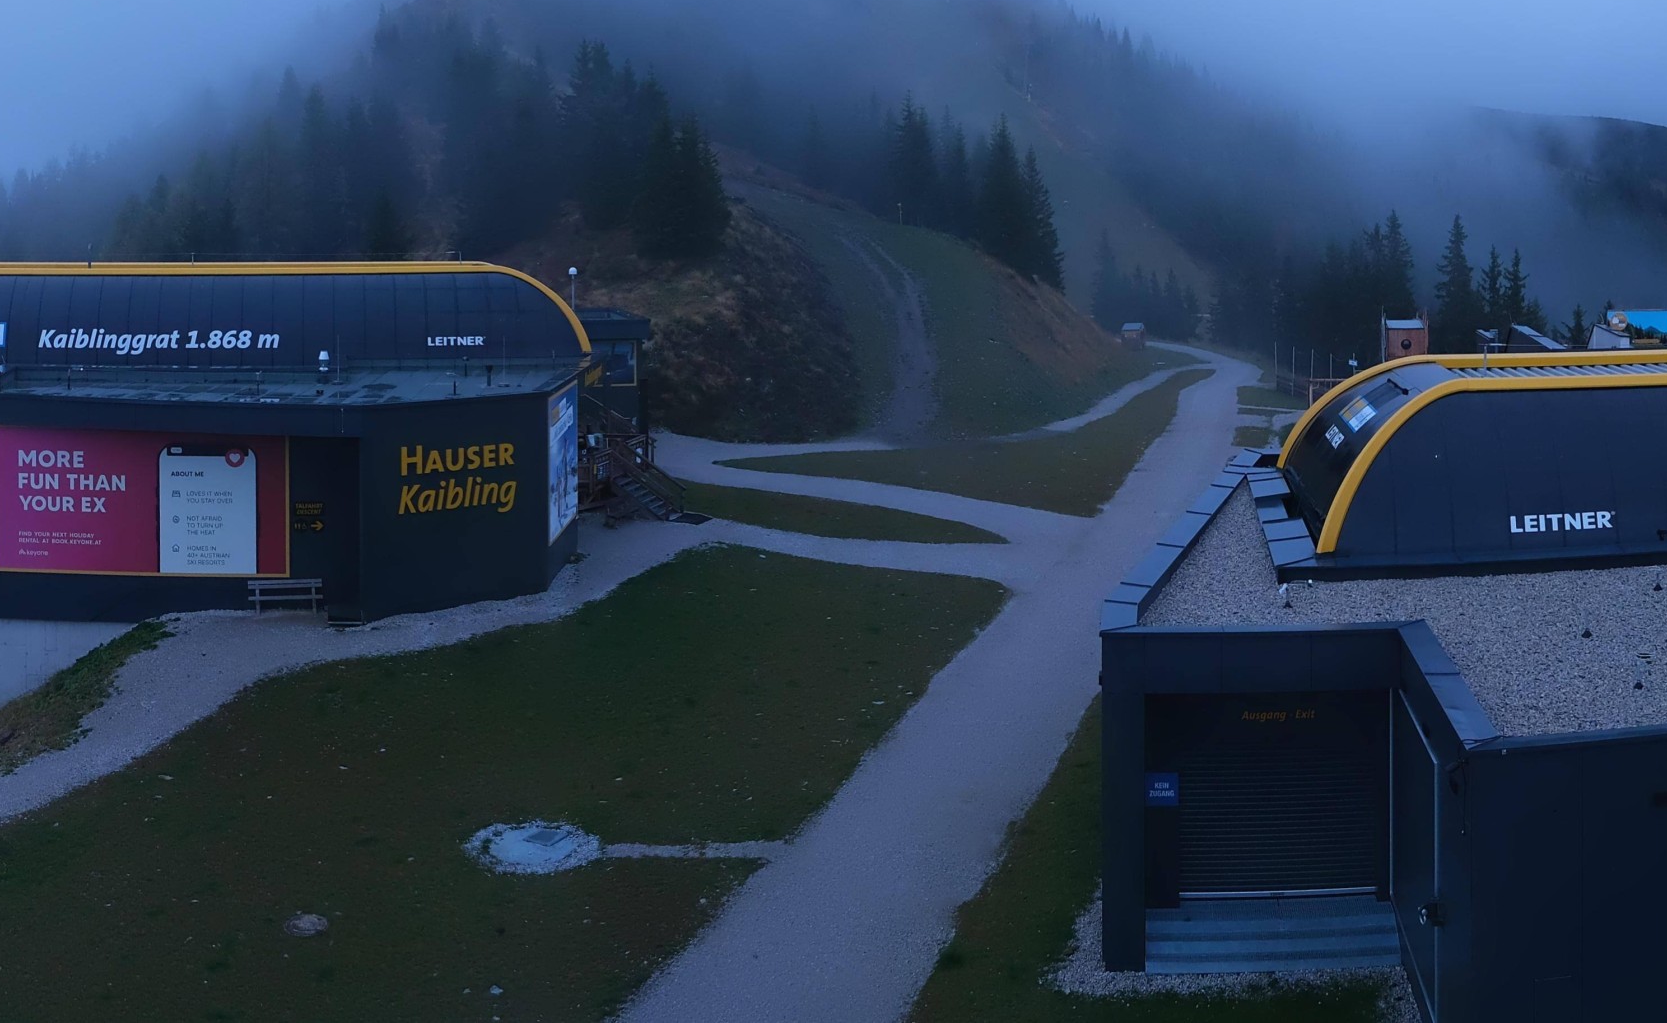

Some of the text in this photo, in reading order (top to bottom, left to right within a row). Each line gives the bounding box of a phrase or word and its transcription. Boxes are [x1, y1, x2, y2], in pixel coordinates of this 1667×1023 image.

[38, 328, 280, 355] Kaiblinggrat 1.868 m
[427, 336, 485, 346] LEITNER
[18, 449, 84, 468] MORE
[400, 443, 515, 476] HAUSER
[18, 472, 126, 491] FUN THAN
[19, 495, 106, 513] YOUR EX
[398, 477, 517, 515] Kaibling
[1509, 511, 1613, 533] LEITNER
[1241, 710, 1287, 723] Ausgang
[1295, 708, 1316, 719] Exit
